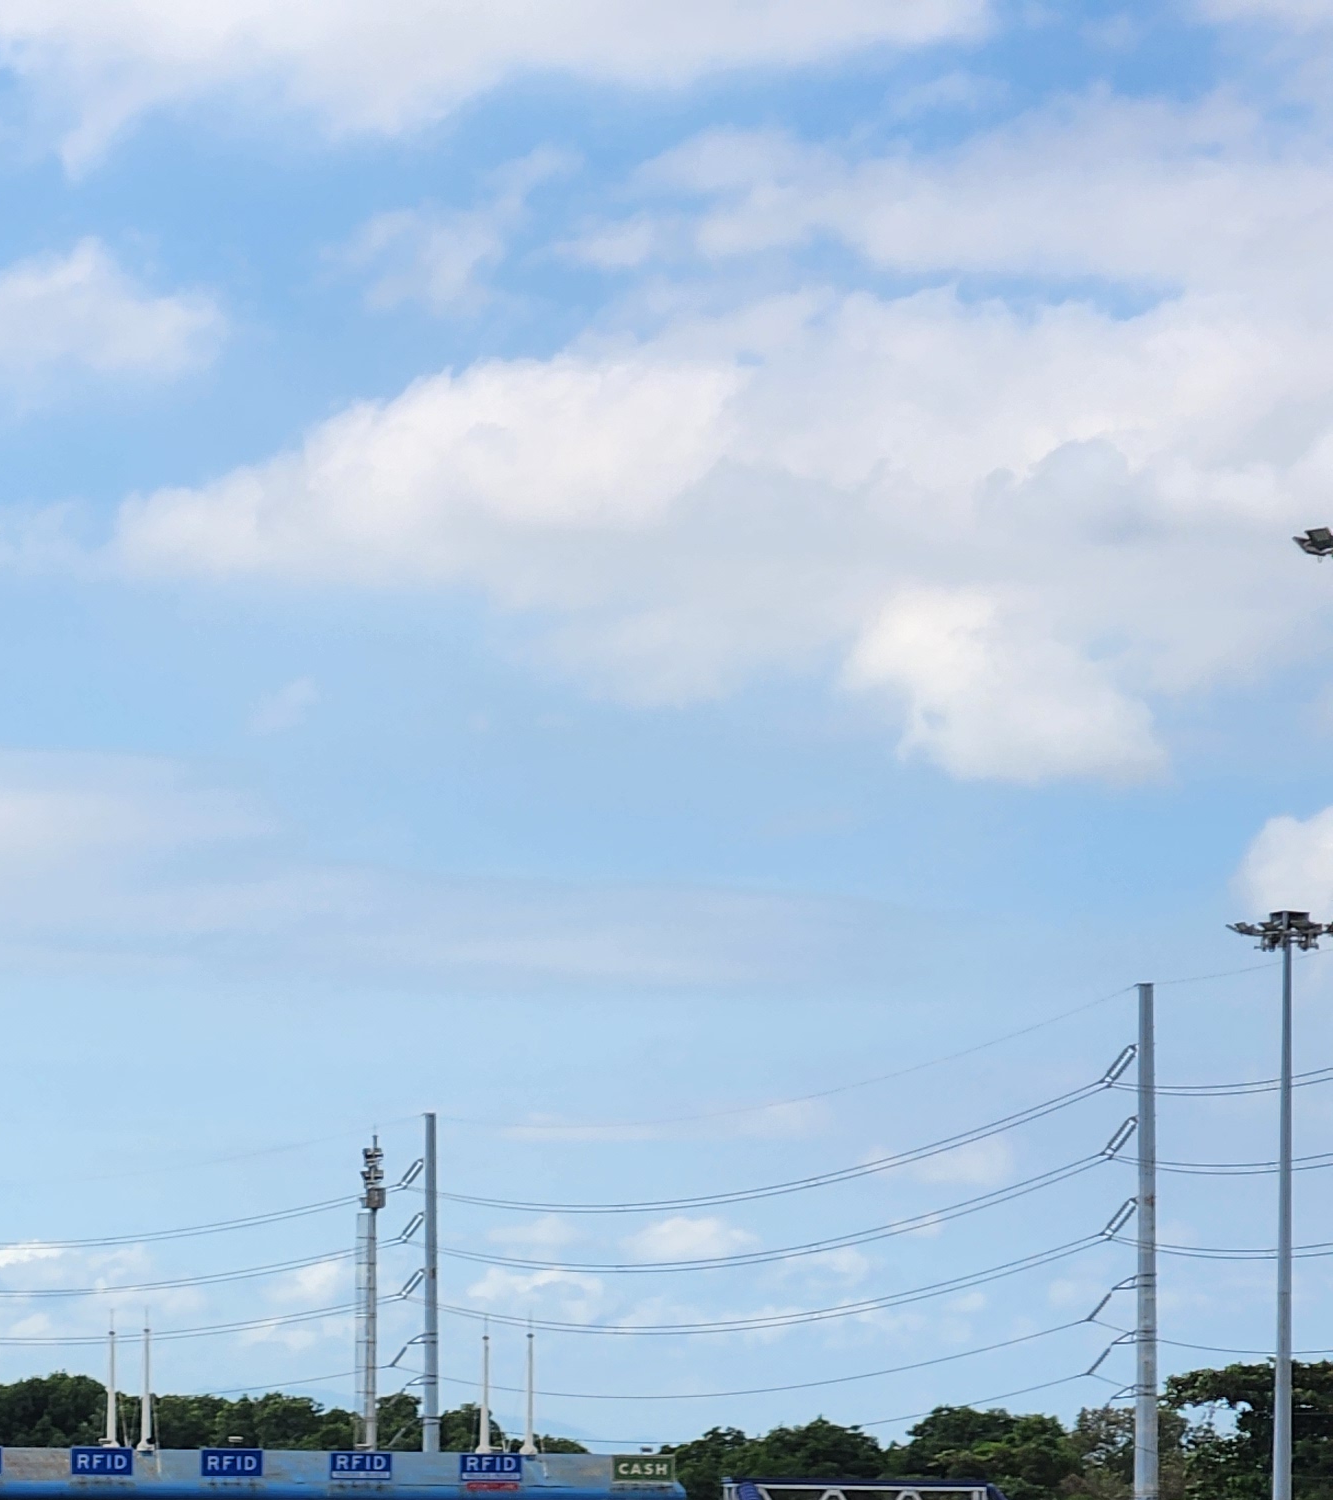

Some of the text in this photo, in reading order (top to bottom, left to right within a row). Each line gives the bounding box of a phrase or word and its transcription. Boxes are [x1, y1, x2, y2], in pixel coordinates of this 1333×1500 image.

[77, 1454, 128, 1470] RFID
[207, 1455, 257, 1471] RFID
[336, 1455, 387, 1470] RFID
[466, 1456, 517, 1472] RFID
[619, 1461, 668, 1476] CASH
